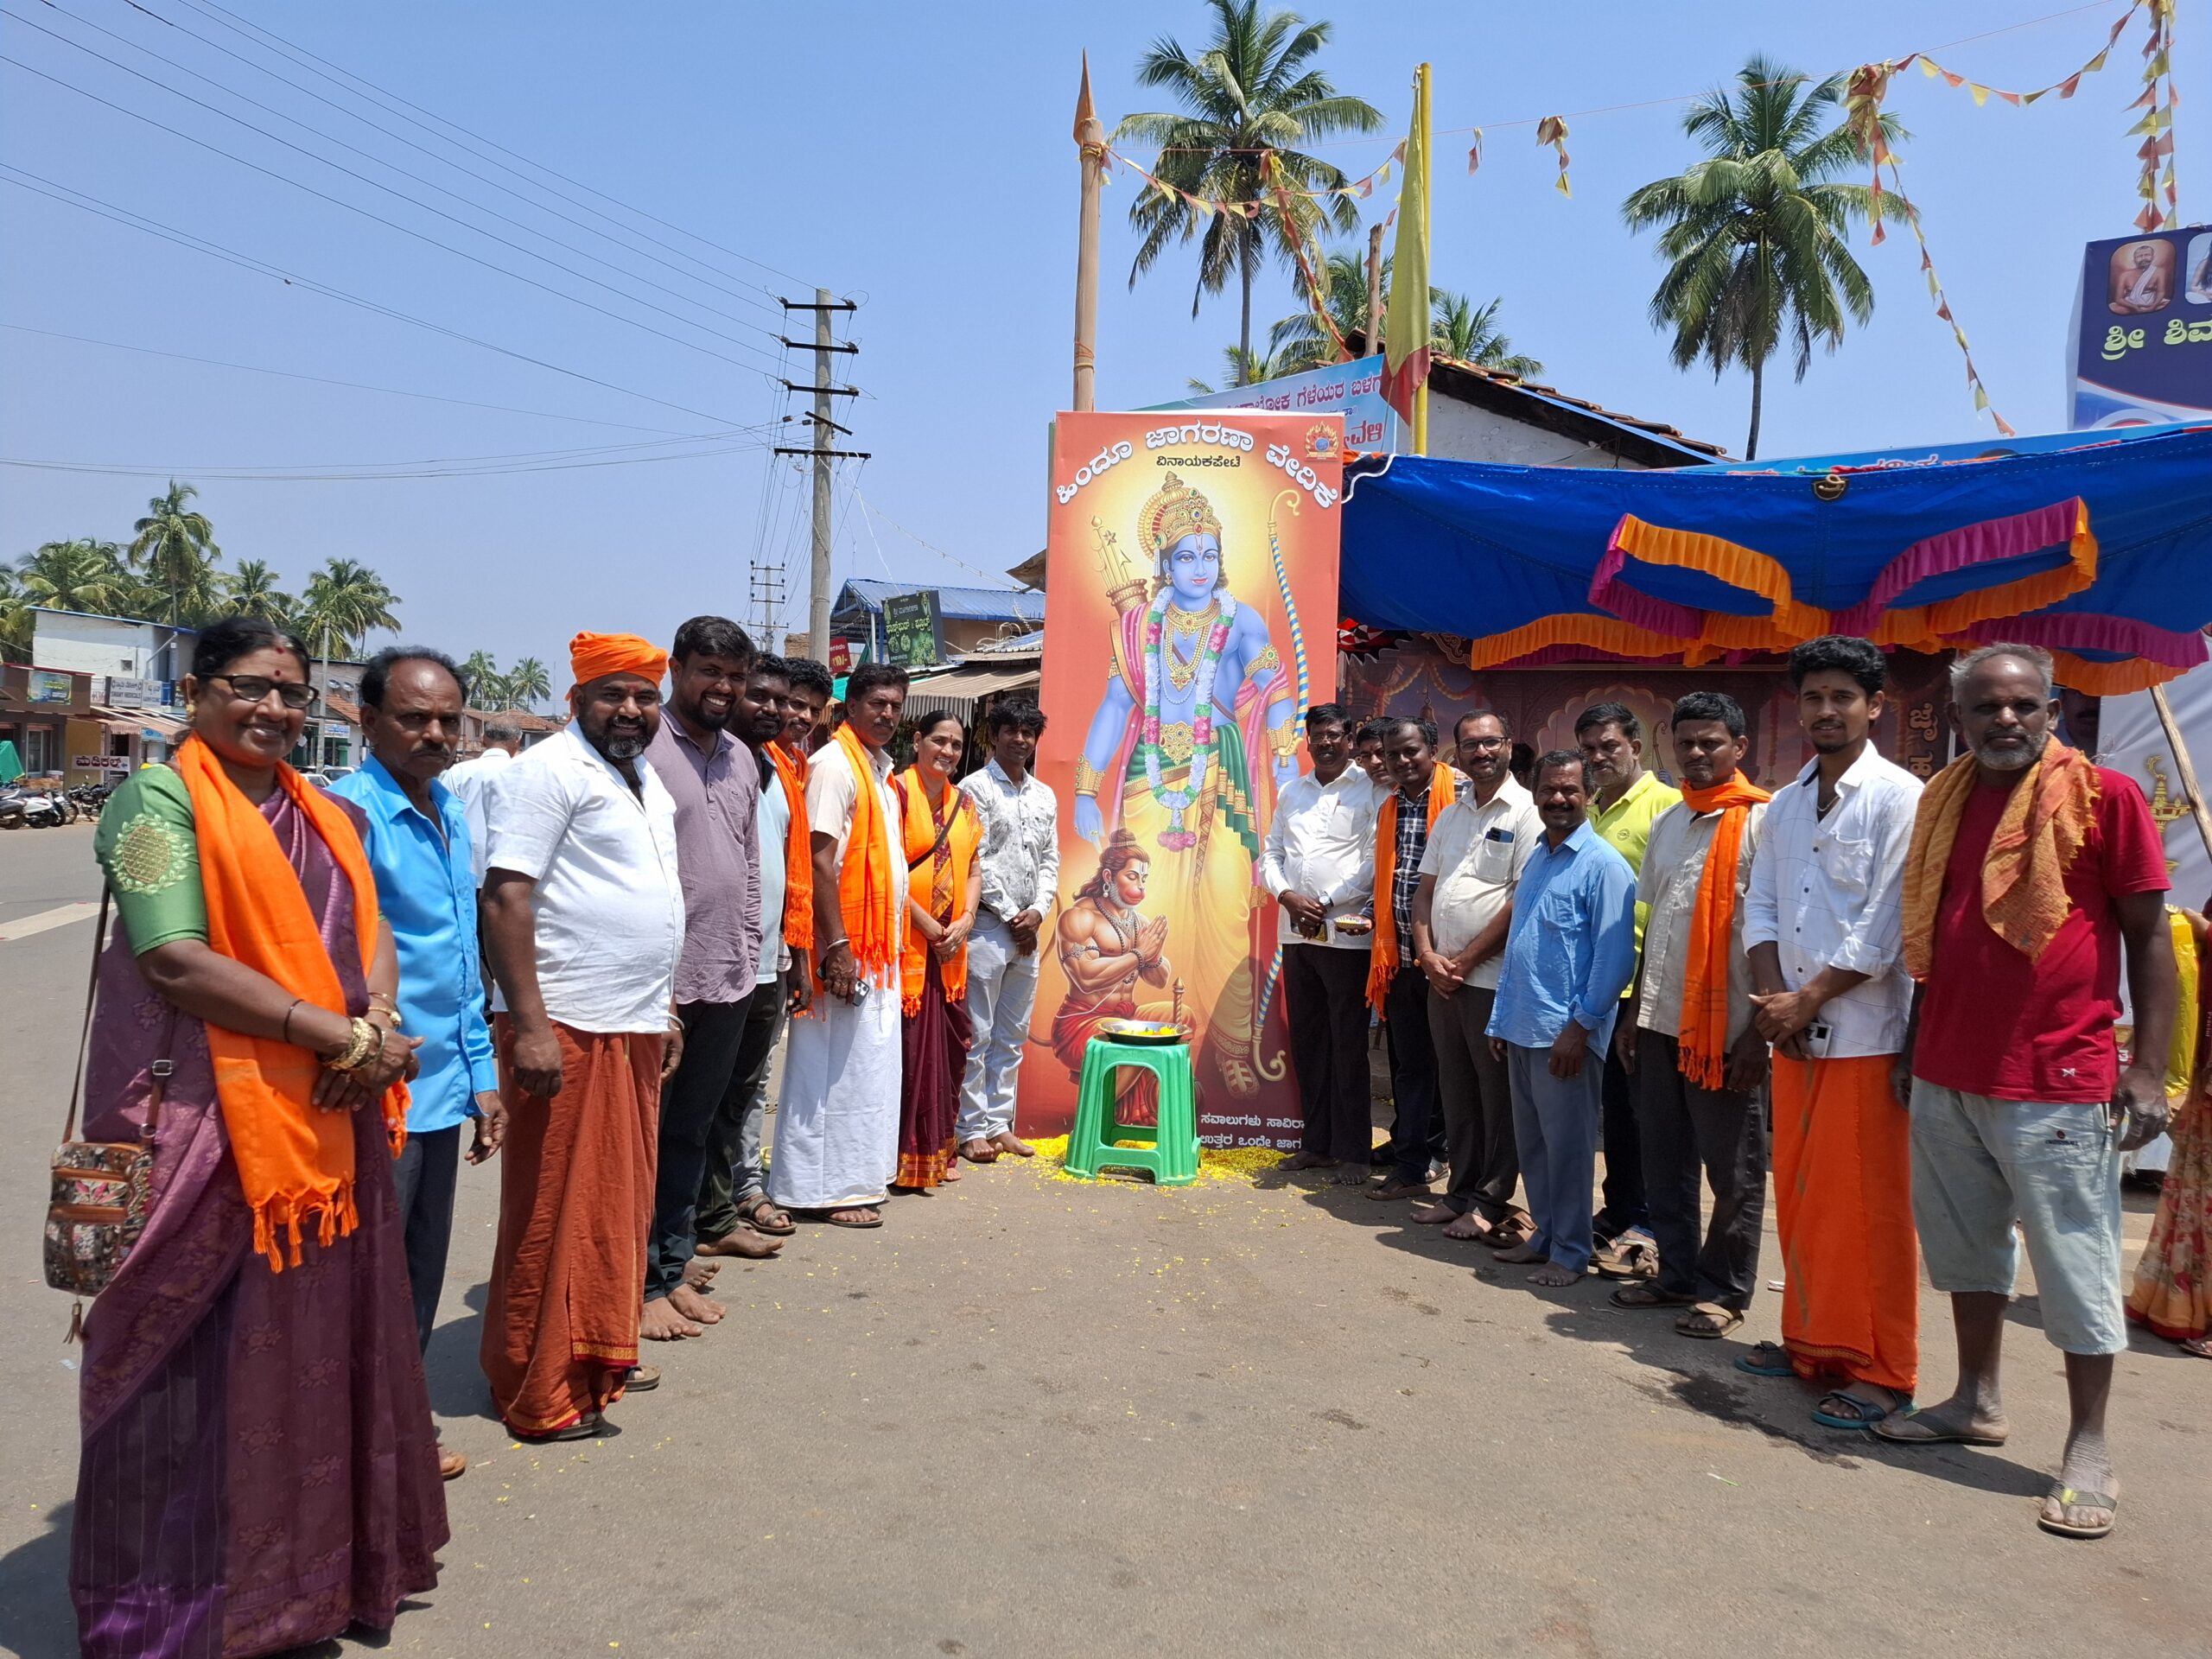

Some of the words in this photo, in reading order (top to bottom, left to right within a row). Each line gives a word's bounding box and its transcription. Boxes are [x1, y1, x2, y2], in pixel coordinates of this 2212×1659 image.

[2101, 325, 2145, 360] ಶ್ರೀ
[1297, 380, 1344, 407] ಗೆಳೆಯರ
[1057, 441, 1133, 504] ಹಿಂದೂ
[1146, 419, 1254, 452] ಜಾಗರಣಾ
[1266, 442, 1338, 508] ವೇದಿಕೆ
[1156, 454, 1241, 467] ವಿನಾಯಕಪೇಟೆ
[1200, 1113, 1261, 1127] ಸವಾಲುಗಳು
[1200, 1134, 1233, 1148] ಉತ್ತರ
[1238, 1135, 1271, 1147] ಒಂದೇ
